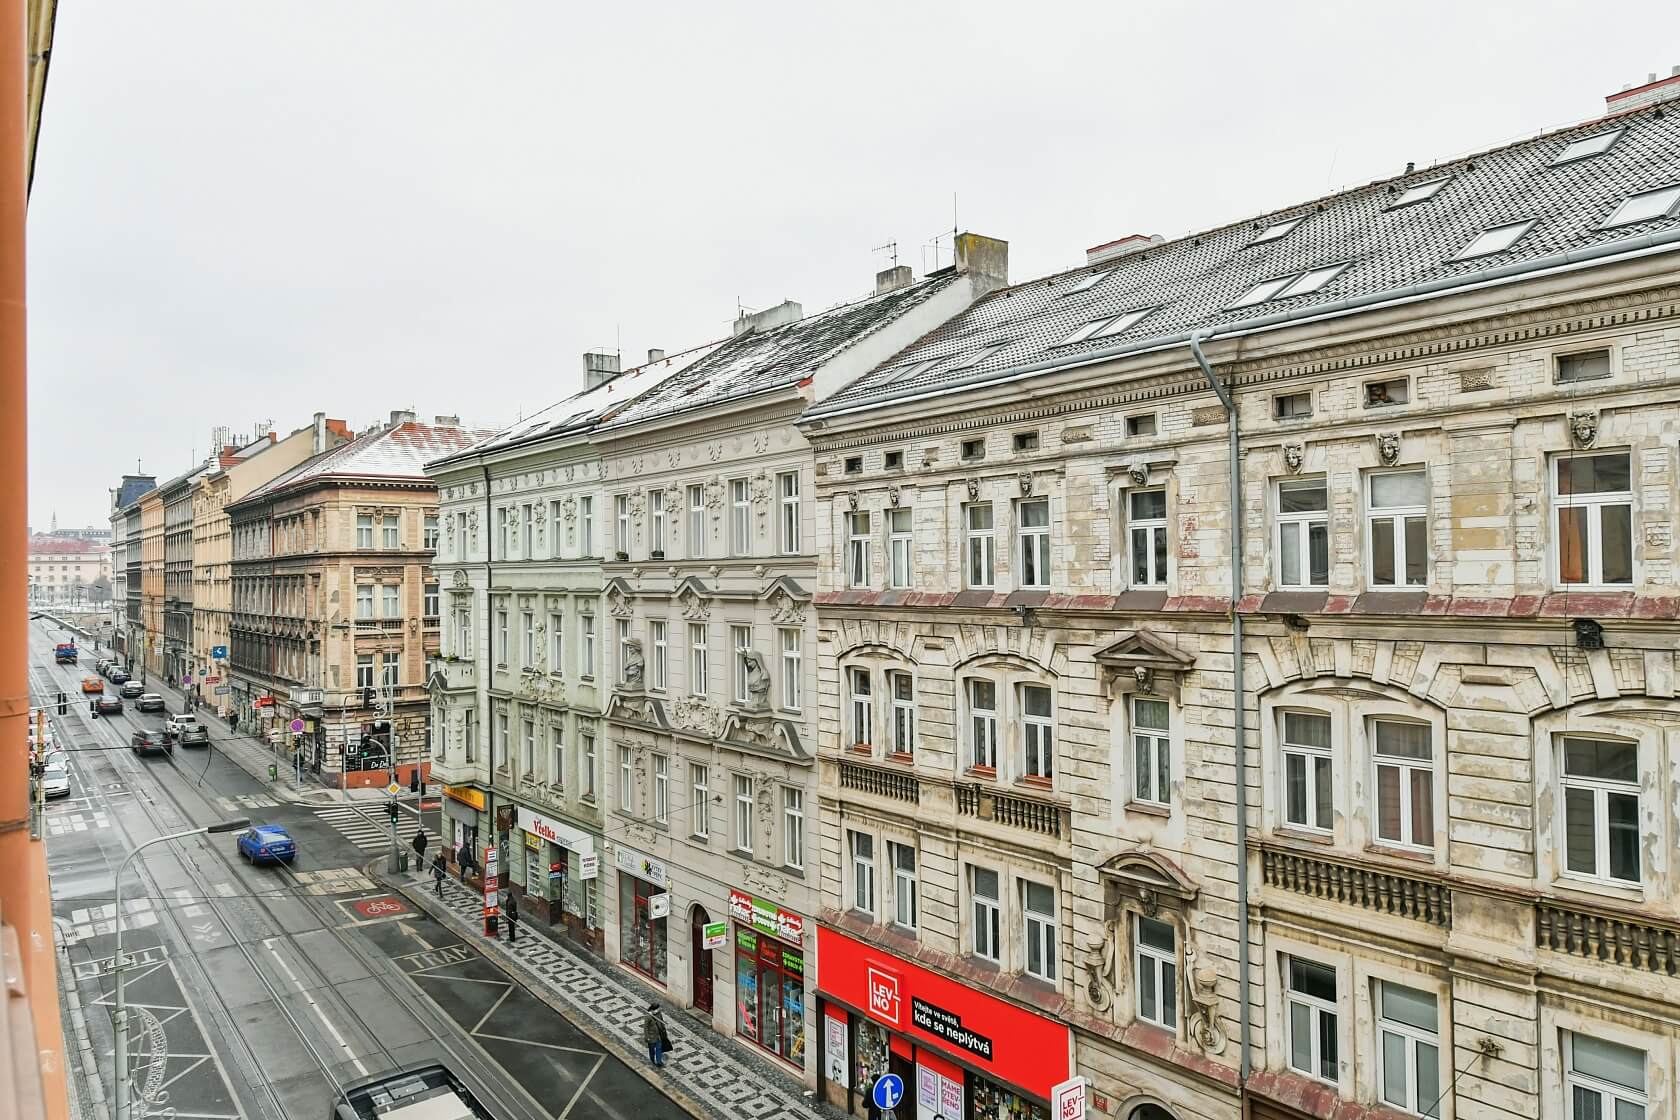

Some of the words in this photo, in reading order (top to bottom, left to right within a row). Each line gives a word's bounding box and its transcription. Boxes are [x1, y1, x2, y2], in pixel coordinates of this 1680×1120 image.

[403, 946, 476, 968] TRAM
[873, 994, 889, 1011] NO
[914, 1000, 933, 1015] Vítejte
[914, 1010, 931, 1027] kde
[934, 1022, 944, 1033] se
[946, 1027, 990, 1055] neplýtvá
[1063, 1107, 1075, 1118] NO
